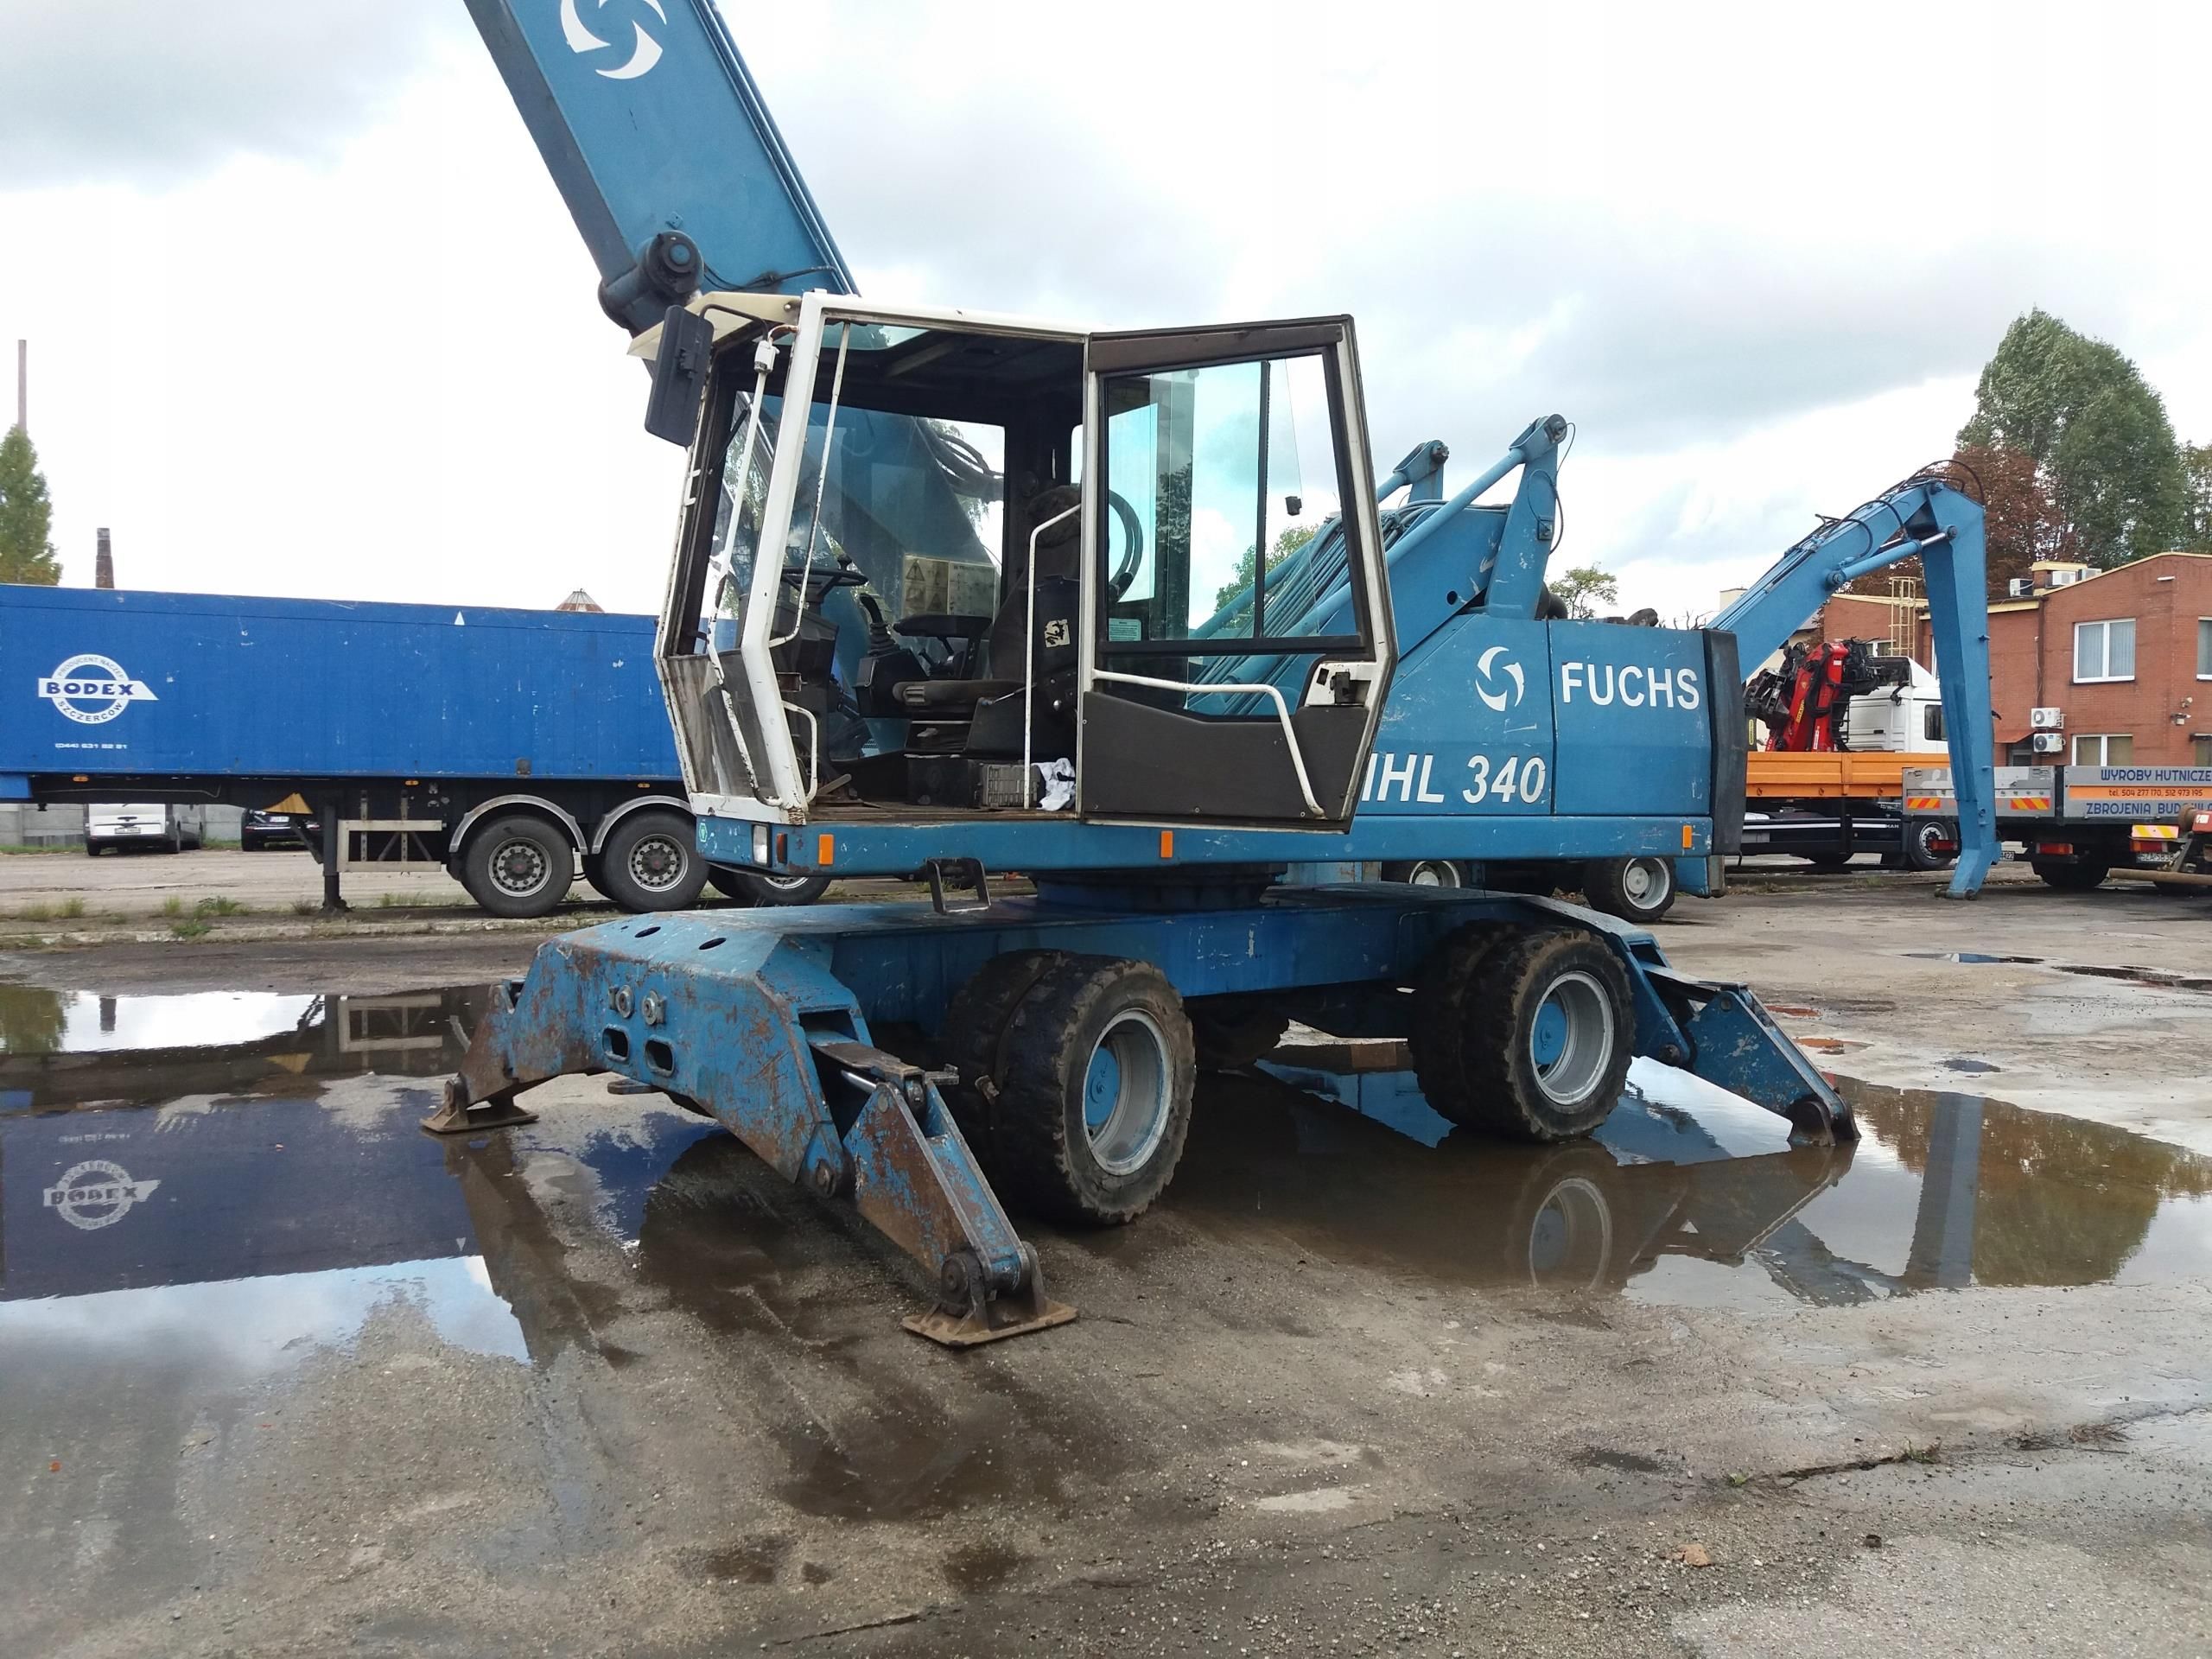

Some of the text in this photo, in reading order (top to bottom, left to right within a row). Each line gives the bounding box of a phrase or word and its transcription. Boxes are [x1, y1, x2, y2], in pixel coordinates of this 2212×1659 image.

[46, 682, 134, 696] BODEX
[1560, 661, 1700, 710] FUCHS
[1461, 754, 1547, 804] 340
[2101, 769, 2212, 782] WYROBY HUTNICZE
[2086, 802, 2152, 815] ZBROJENIA
